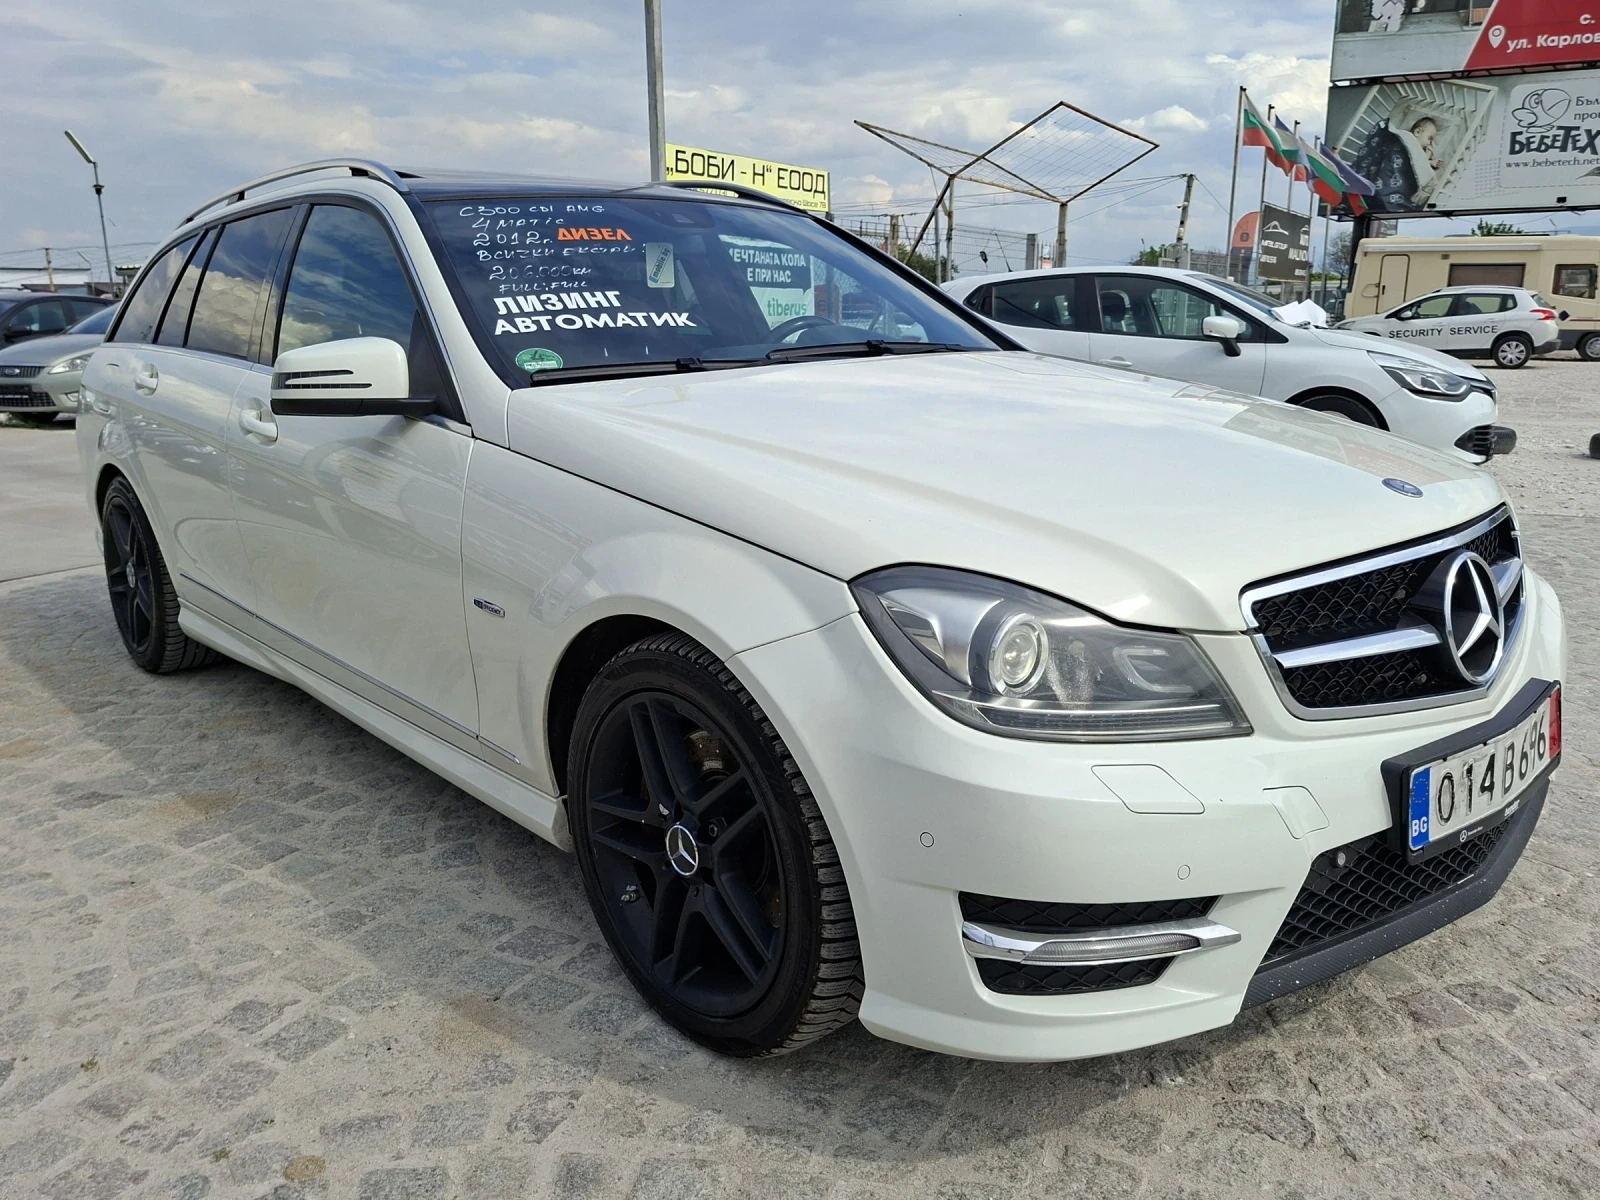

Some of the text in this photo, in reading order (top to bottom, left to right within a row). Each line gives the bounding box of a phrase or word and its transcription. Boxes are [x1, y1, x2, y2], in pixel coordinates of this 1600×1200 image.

[1579, 14, 1596, 25] с.
[1506, 38, 1532, 53] ул.
[777, 167, 826, 200] ЕООД
[459, 206, 520, 217] C300
[566, 204, 605, 213] AMG
[557, 227, 632, 240] ДИЗЕЛ
[652, 247, 671, 278] mobile.bg
[781, 254, 806, 267] КОЛА
[747, 268, 791, 283] Е ПРИ НАС
[494, 290, 621, 315] ЛИЗИНГ
[767, 297, 807, 317] tiberus
[494, 312, 697, 335] АВТОМАТИК
[1388, 325, 1498, 339] SECURITY SERVICE
[1411, 816, 1428, 837] BG
